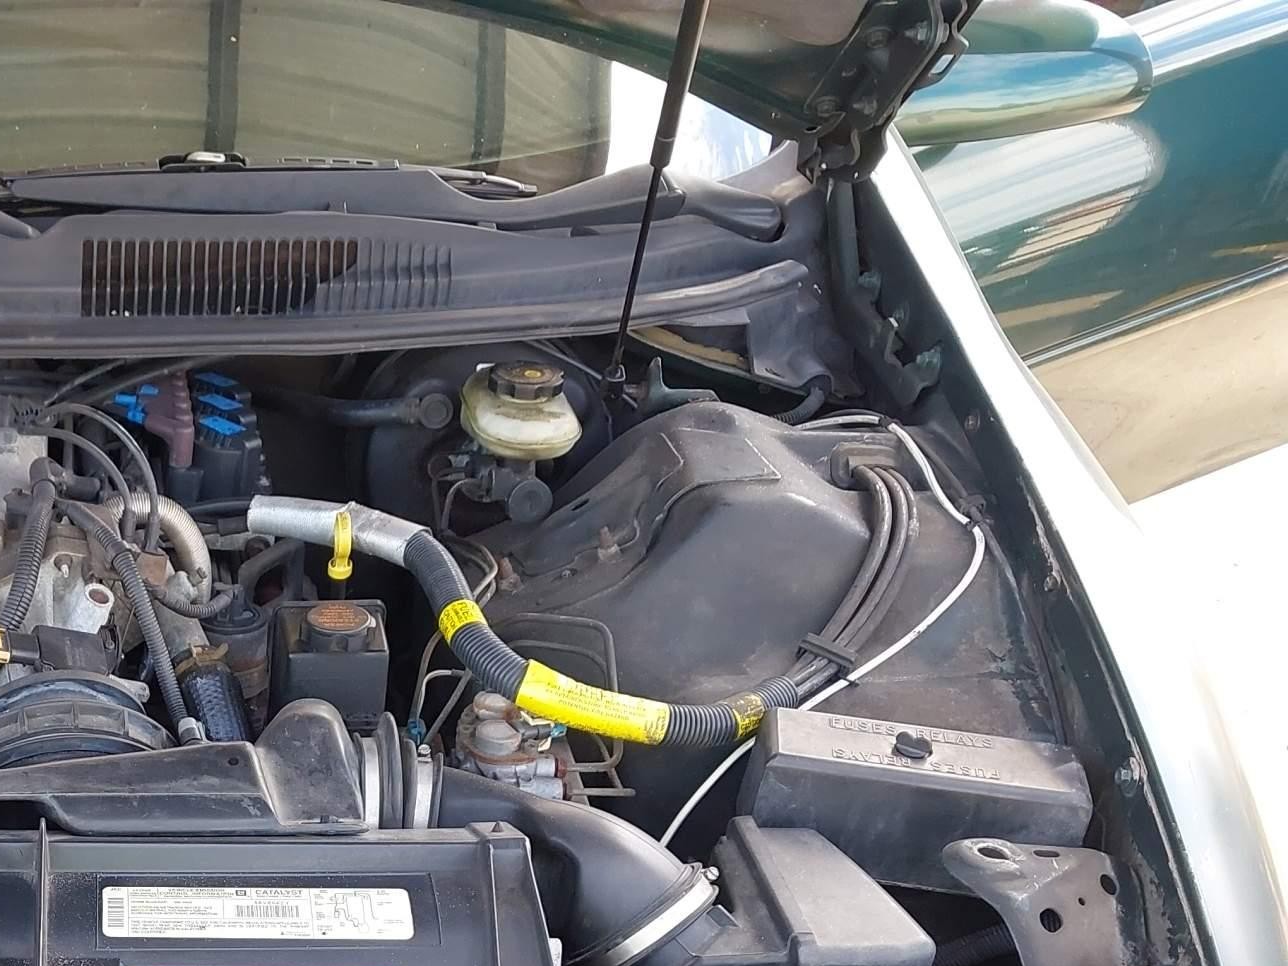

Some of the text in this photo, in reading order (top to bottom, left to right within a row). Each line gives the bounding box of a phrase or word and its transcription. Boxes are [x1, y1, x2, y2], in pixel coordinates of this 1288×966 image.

[828, 716, 994, 748] FUSES RELAYS
[930, 759, 1001, 780] FUSES
